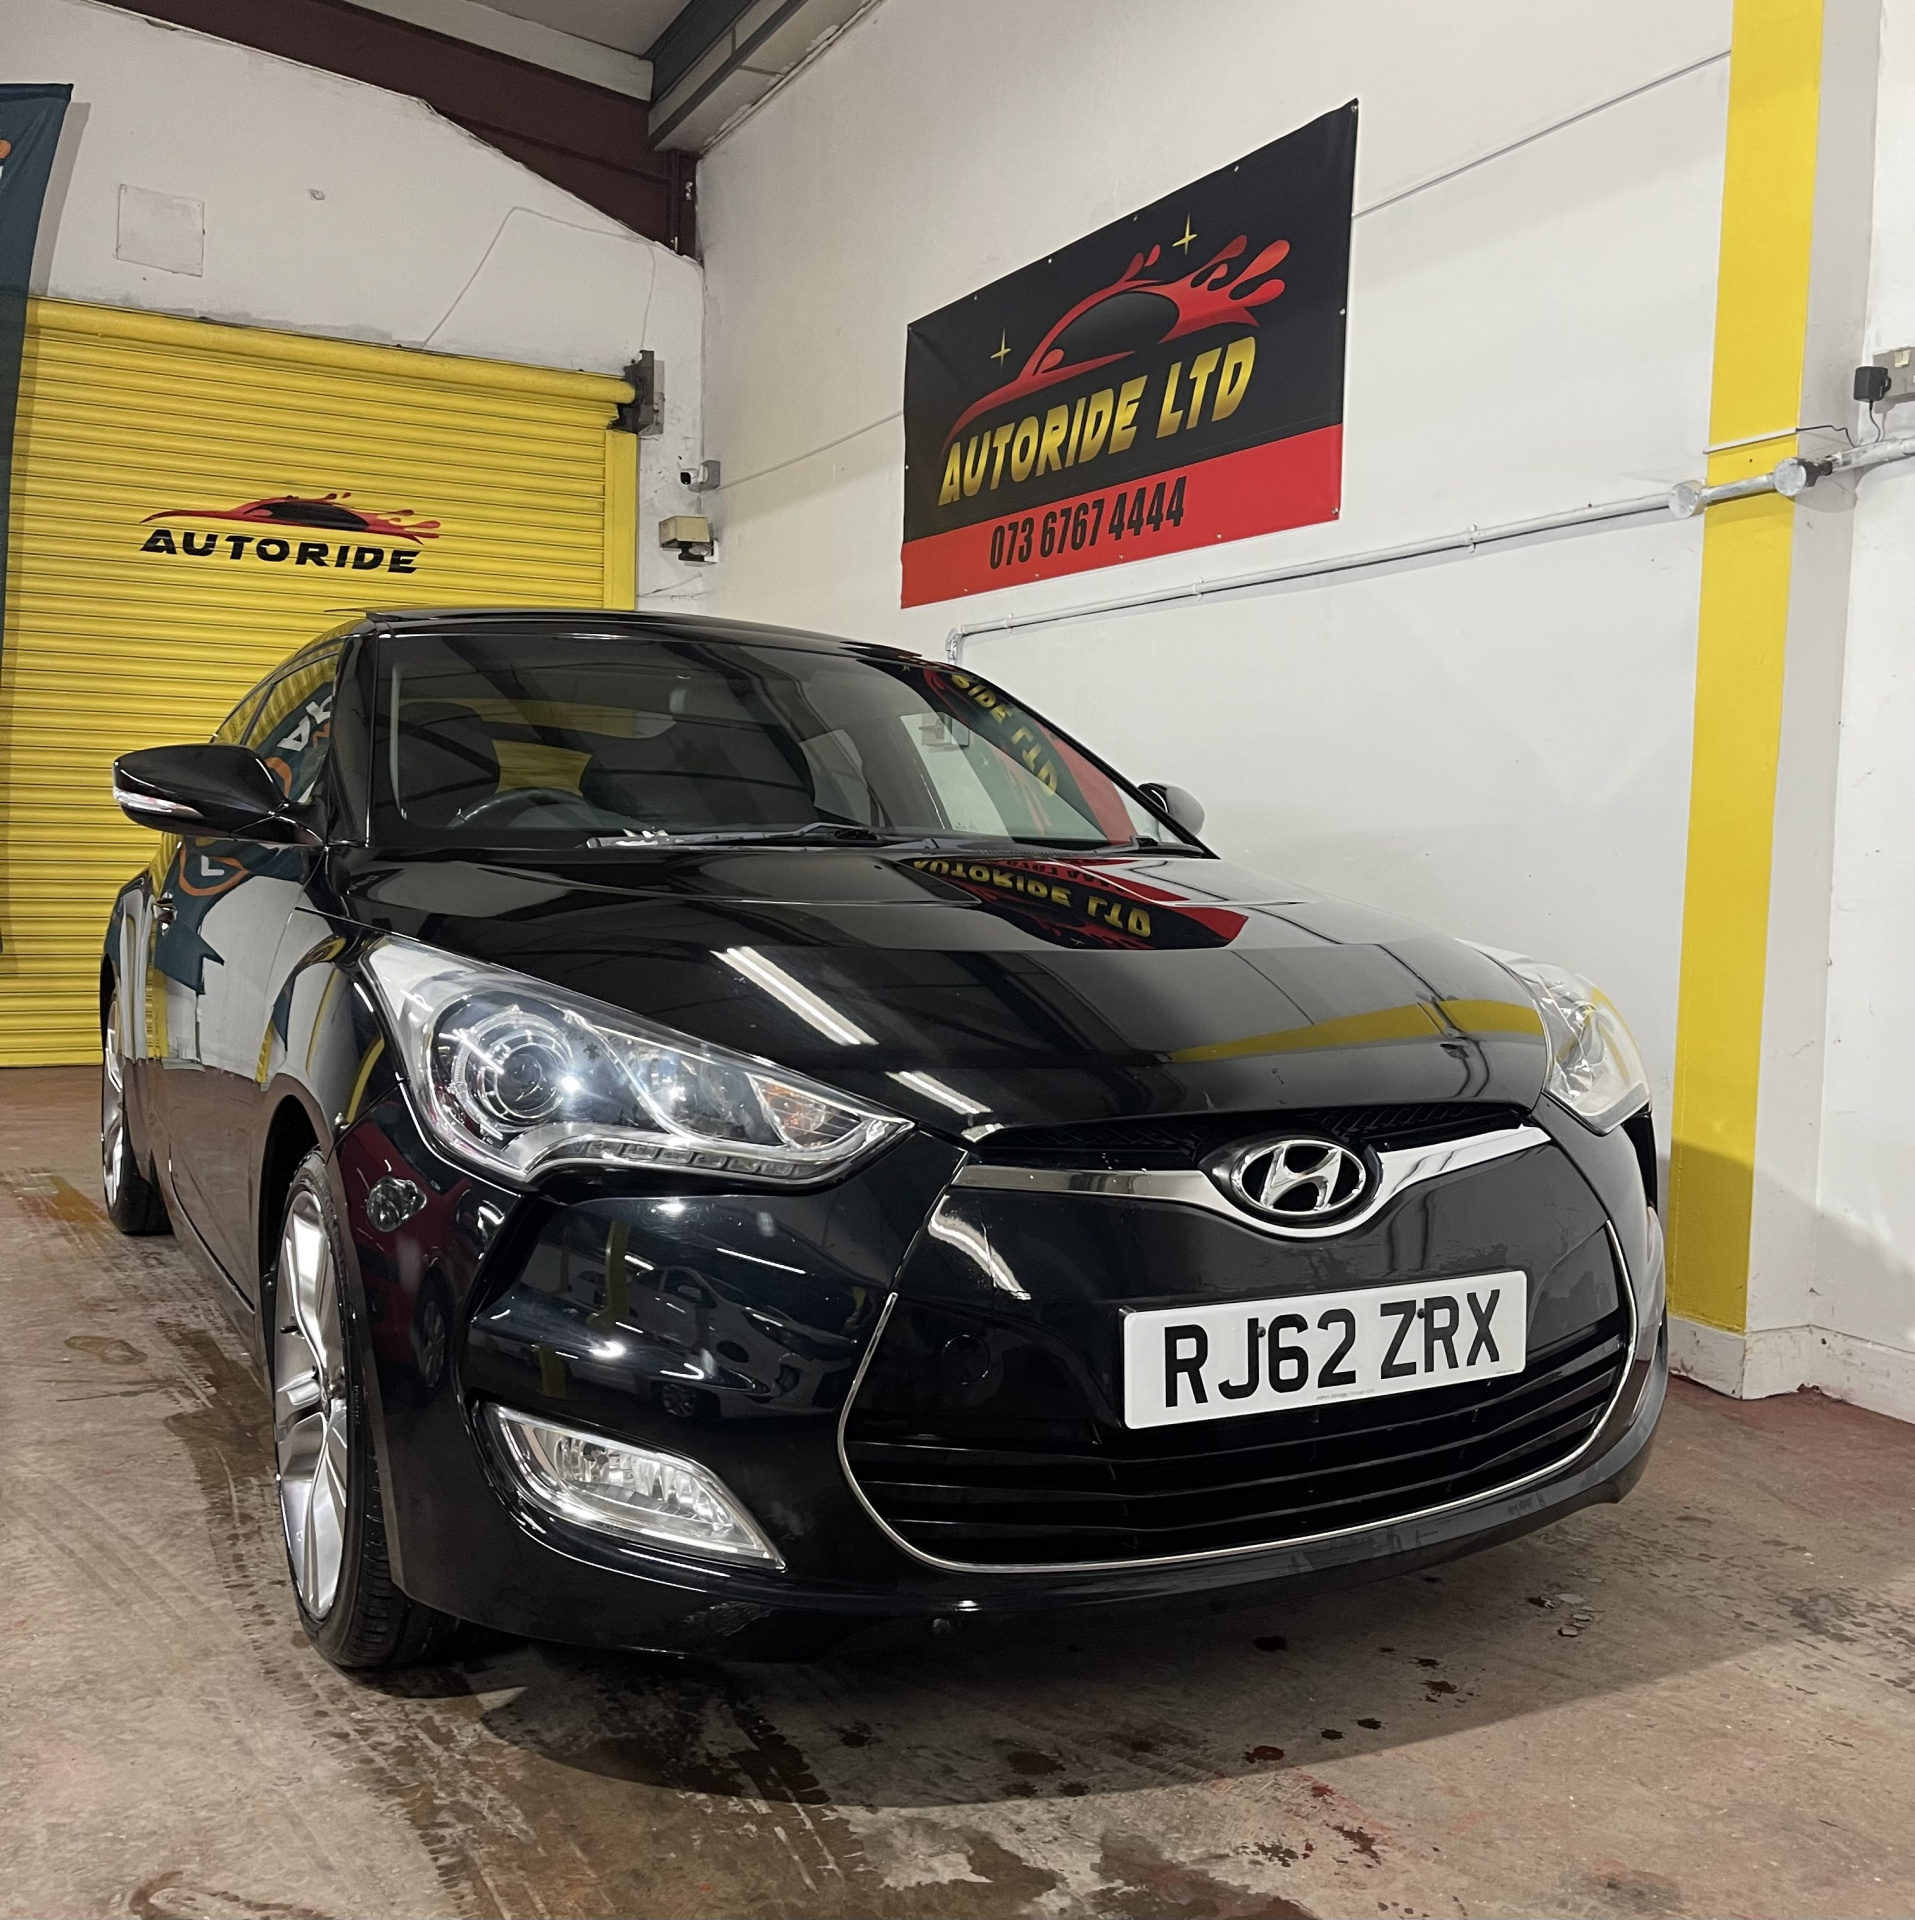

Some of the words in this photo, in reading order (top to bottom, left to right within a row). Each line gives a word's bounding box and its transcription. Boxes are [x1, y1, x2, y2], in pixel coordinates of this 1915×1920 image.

[938, 375, 1148, 506] AUTORIDE
[1156, 336, 1256, 439] LTD
[139, 529, 421, 574] AUTORIDE
[989, 517, 1034, 569] 073
[1040, 498, 1105, 558] 6767
[1108, 476, 1187, 541] 4444
[1165, 1308, 1357, 1408] RJ62
[1380, 1289, 1500, 1380] ZRX
